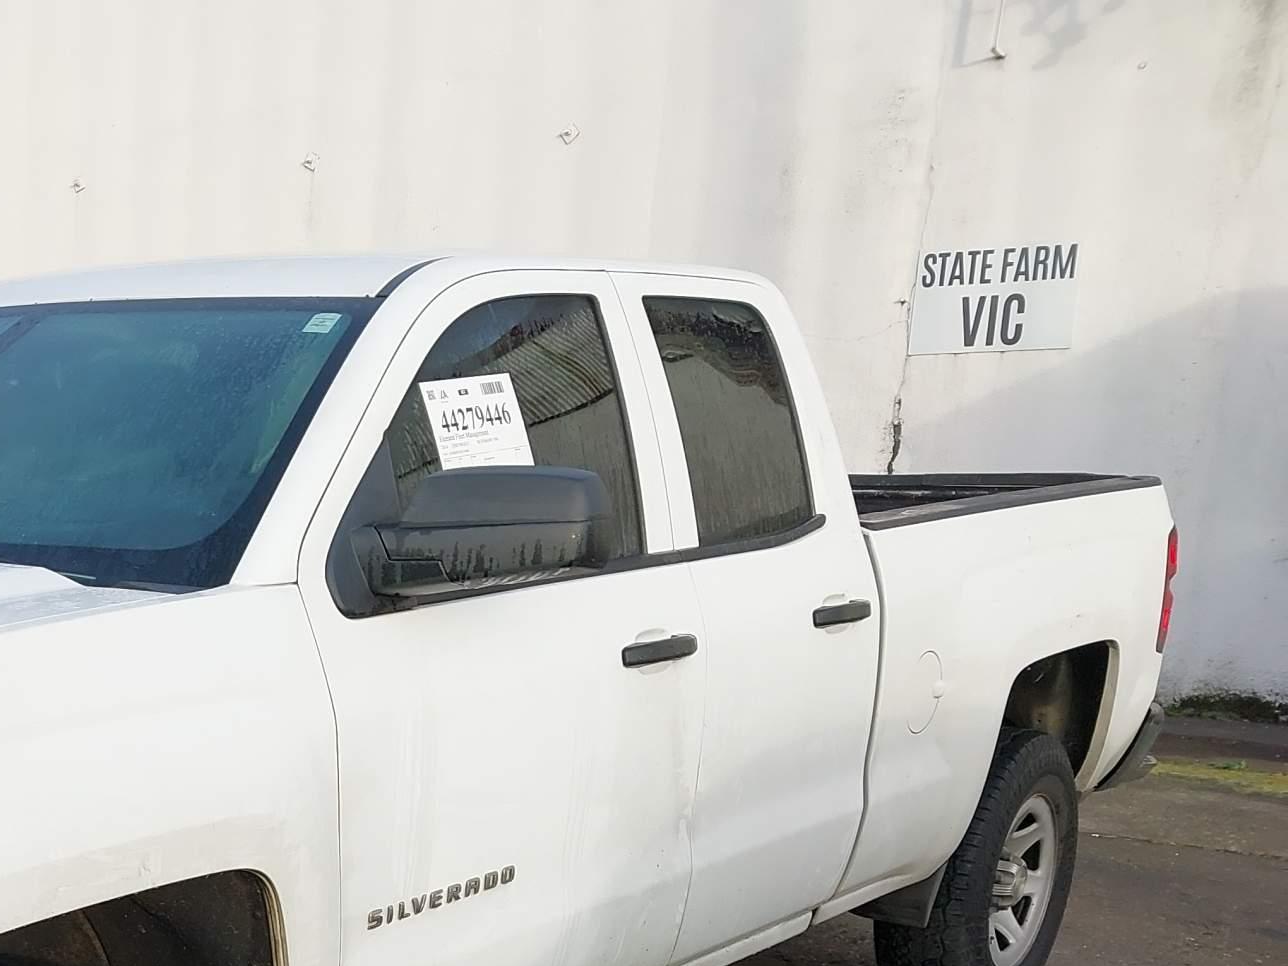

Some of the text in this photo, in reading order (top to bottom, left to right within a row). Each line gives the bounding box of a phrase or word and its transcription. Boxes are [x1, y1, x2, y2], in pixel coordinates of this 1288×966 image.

[921, 243, 1079, 288] STATE FARM
[961, 293, 1026, 347] VIC
[441, 402, 511, 433] 44279446
[366, 864, 516, 931] SILVERADO
